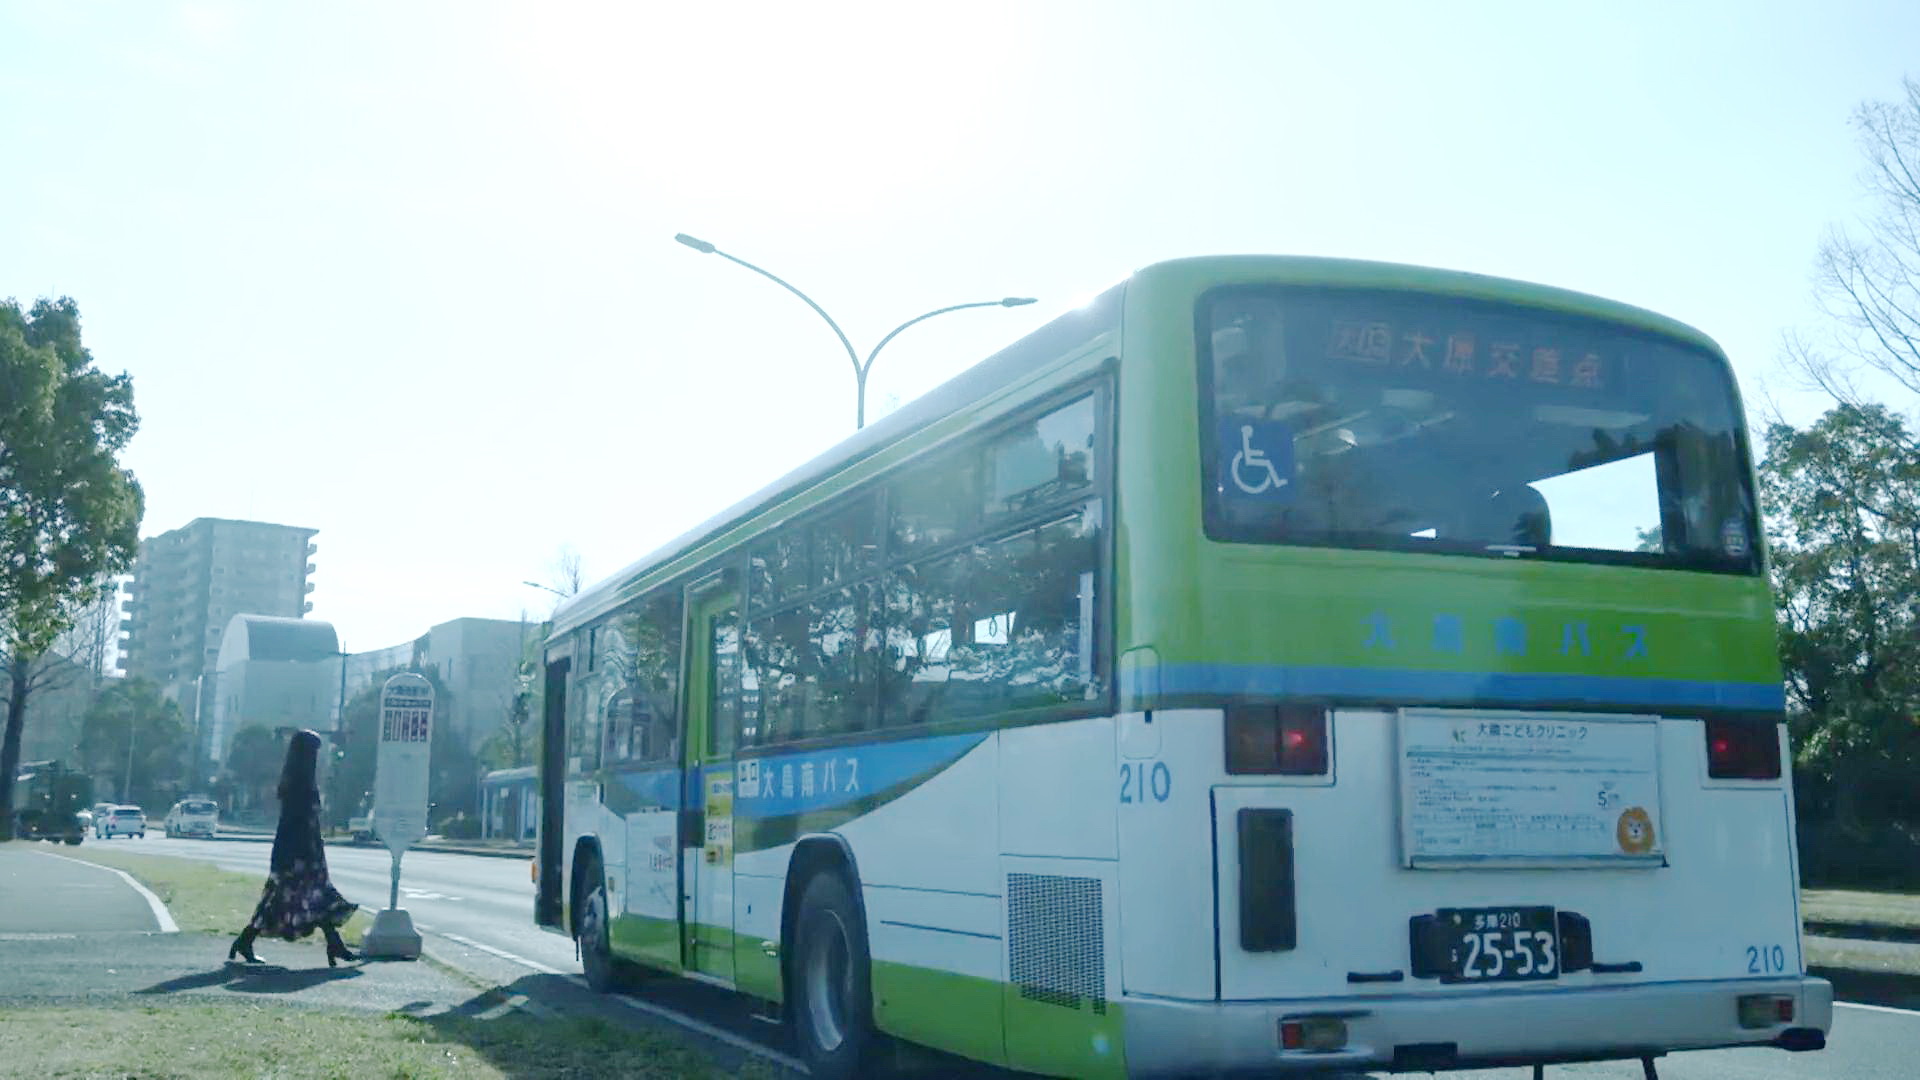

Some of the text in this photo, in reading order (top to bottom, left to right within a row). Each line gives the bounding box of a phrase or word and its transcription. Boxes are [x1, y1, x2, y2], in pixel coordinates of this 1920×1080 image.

[1119, 761, 1172, 804] 210
[1462, 930, 1556, 977] 25-53
[1746, 943, 1785, 974] 210
